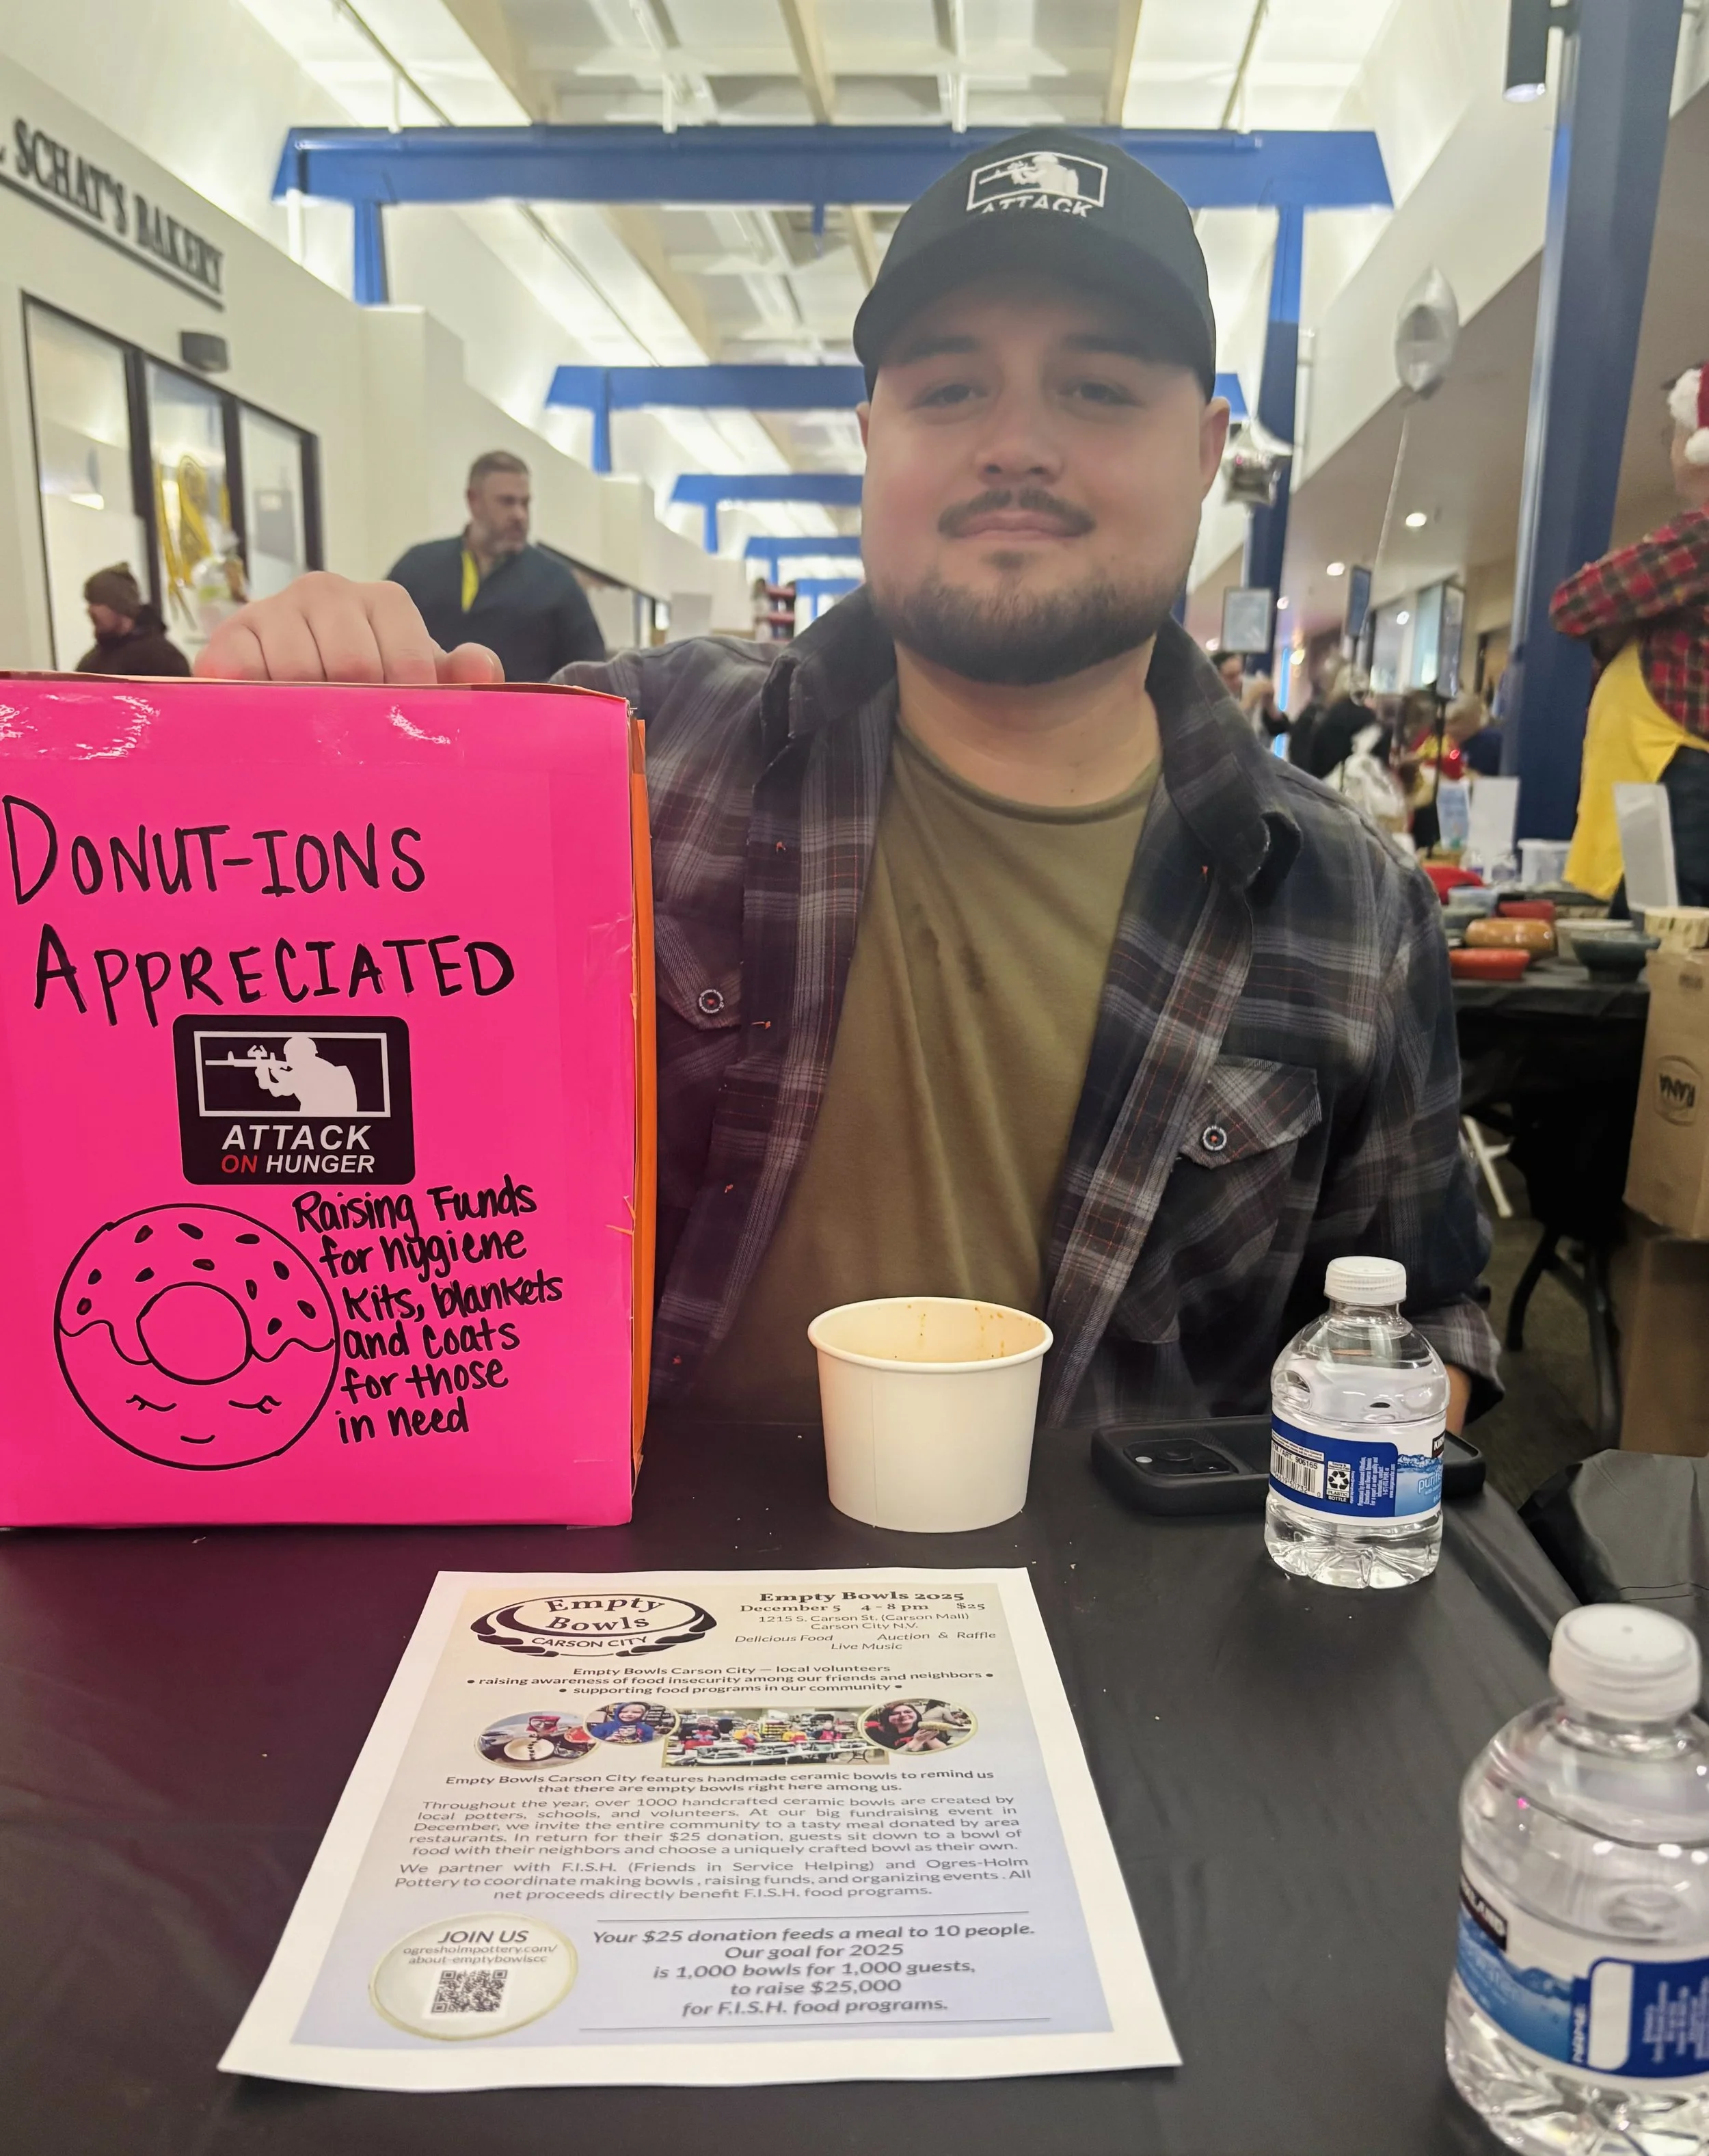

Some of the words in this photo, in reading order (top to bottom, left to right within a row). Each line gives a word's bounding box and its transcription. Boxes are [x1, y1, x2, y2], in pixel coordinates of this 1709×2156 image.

[14, 118, 127, 236] SCHAT'S
[135, 193, 223, 294] BAKERY
[2, 795, 425, 905] DONUT-IONS
[34, 923, 515, 1028] APPRECIATED
[221, 1125, 372, 1150] ATTACK
[221, 1155, 258, 1173] ON
[266, 1155, 375, 1173] HUNGER
[292, 1190, 420, 1239] Raising
[427, 1174, 537, 1221] Funds
[319, 1234, 373, 1278] for
[380, 1229, 527, 1282] hygiene
[432, 1269, 563, 1318] blankets
[343, 1320, 409, 1359] and
[341, 1367, 399, 1404] for
[405, 1359, 508, 1399] those
[335, 1410, 375, 1443] in
[388, 1396, 468, 1437] need
[1295, 1457, 1318, 1469] 906165
[1289, 1481, 1308, 1494] 50732
[545, 1596, 665, 1612] Empty
[759, 1593, 835, 1603] Empty
[842, 1591, 909, 1600] Bowls
[915, 1593, 964, 1601] 2025
[740, 1603, 828, 1612] December
[546, 1616, 649, 1631] Bowls
[532, 1637, 603, 1647] CARSON
[608, 1636, 647, 1647] CITY
[877, 1632, 930, 1640] Auction
[479, 1677, 528, 1686] raising
[669, 1675, 740, 1683] insecurity
[910, 1671, 982, 1680] neighbors
[574, 1668, 620, 1676] Empty
[445, 1776, 495, 1785] Empty
[499, 1775, 544, 1783] Bowls
[548, 1774, 601, 1783] Carson
[606, 1774, 636, 1783] City
[708, 1774, 786, 1782] handmade
[790, 1772, 850, 1781] ceramic
[921, 1770, 973, 1779] remind
[423, 1801, 515, 1810] Throughout
[682, 1797, 778, 1806] handcrafted
[783, 1797, 847, 1807] ceramic
[850, 1797, 895, 1806] bowls
[931, 1796, 990, 1805] created
[996, 1796, 1014, 1805] by
[400, 1864, 429, 1873] We
[439, 1864, 503, 1875] partner
[514, 1862, 550, 1872] with
[562, 1862, 616, 1872] F.I.S.H.
[629, 1861, 696, 1873] (Friends
[707, 1863, 721, 1872] in
[733, 1862, 793, 1871] Service
[805, 1861, 874, 1872] Helping)
[886, 1861, 915, 1869] and
[926, 1859, 1029, 1869] Ogres-Holm
[438, 1931, 494, 1943] JOIN
[499, 1930, 529, 1943] US
[594, 1932, 638, 1943] Your
[643, 1930, 684, 1943] $25
[688, 1929, 777, 1942] donation
[782, 1928, 833, 1941] feeds
[839, 1930, 850, 1939] a
[856, 1927, 902, 1939] meal
[909, 1927, 928, 1937] to
[935, 1925, 960, 1937] 10
[965, 1924, 1034, 1938] people.
[725, 1947, 764, 1958] Our
[767, 1945, 810, 1960] goal
[816, 1945, 844, 1958] for
[850, 1943, 904, 1956] 2025
[653, 1967, 669, 1978] is
[676, 1965, 736, 1979] 1,000
[742, 1963, 801, 1976] bowls
[807, 1962, 835, 1976] for
[842, 1962, 901, 1975] 1,000
[906, 1960, 975, 1975] guests,
[731, 1984, 751, 1995] to
[755, 1982, 805, 1994] raise
[810, 1979, 901, 1994] $25,000
[683, 2003, 713, 2018] for
[718, 2001, 787, 2015] F.I.S.H.
[793, 2000, 839, 2014] food
[845, 1998, 947, 2014] programs.
